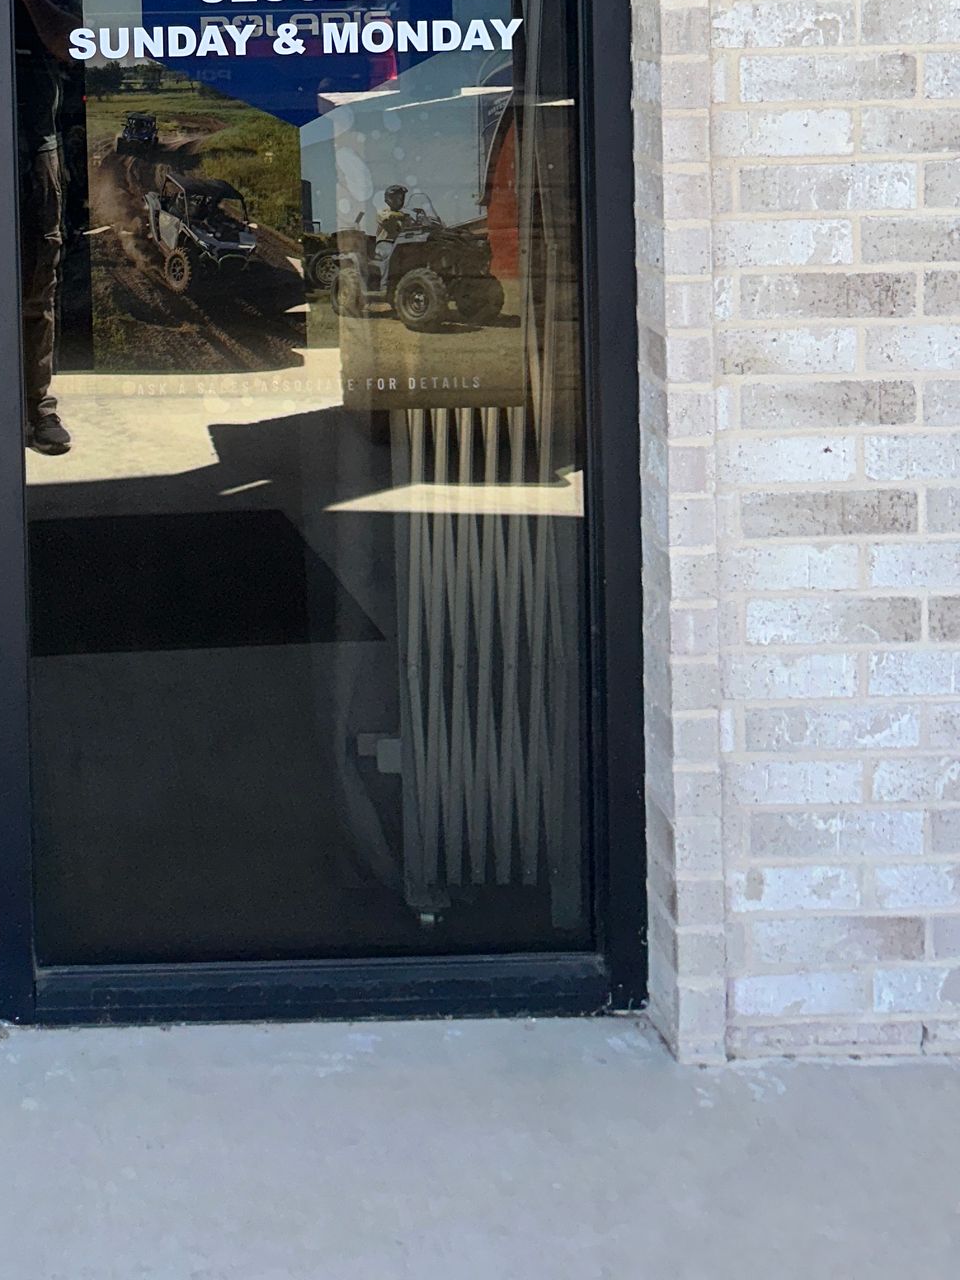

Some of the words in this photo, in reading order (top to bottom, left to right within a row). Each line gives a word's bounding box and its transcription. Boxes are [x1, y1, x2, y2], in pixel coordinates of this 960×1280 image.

[69, 24, 257, 60] SUNDAY
[273, 23, 307, 55] &
[323, 19, 523, 54] MONDAY
[137, 383, 167, 396] ASK
[178, 383, 186, 395] A
[197, 380, 249, 395] SALES
[366, 377, 396, 391] FOR
[408, 376, 481, 390] DETAILS
